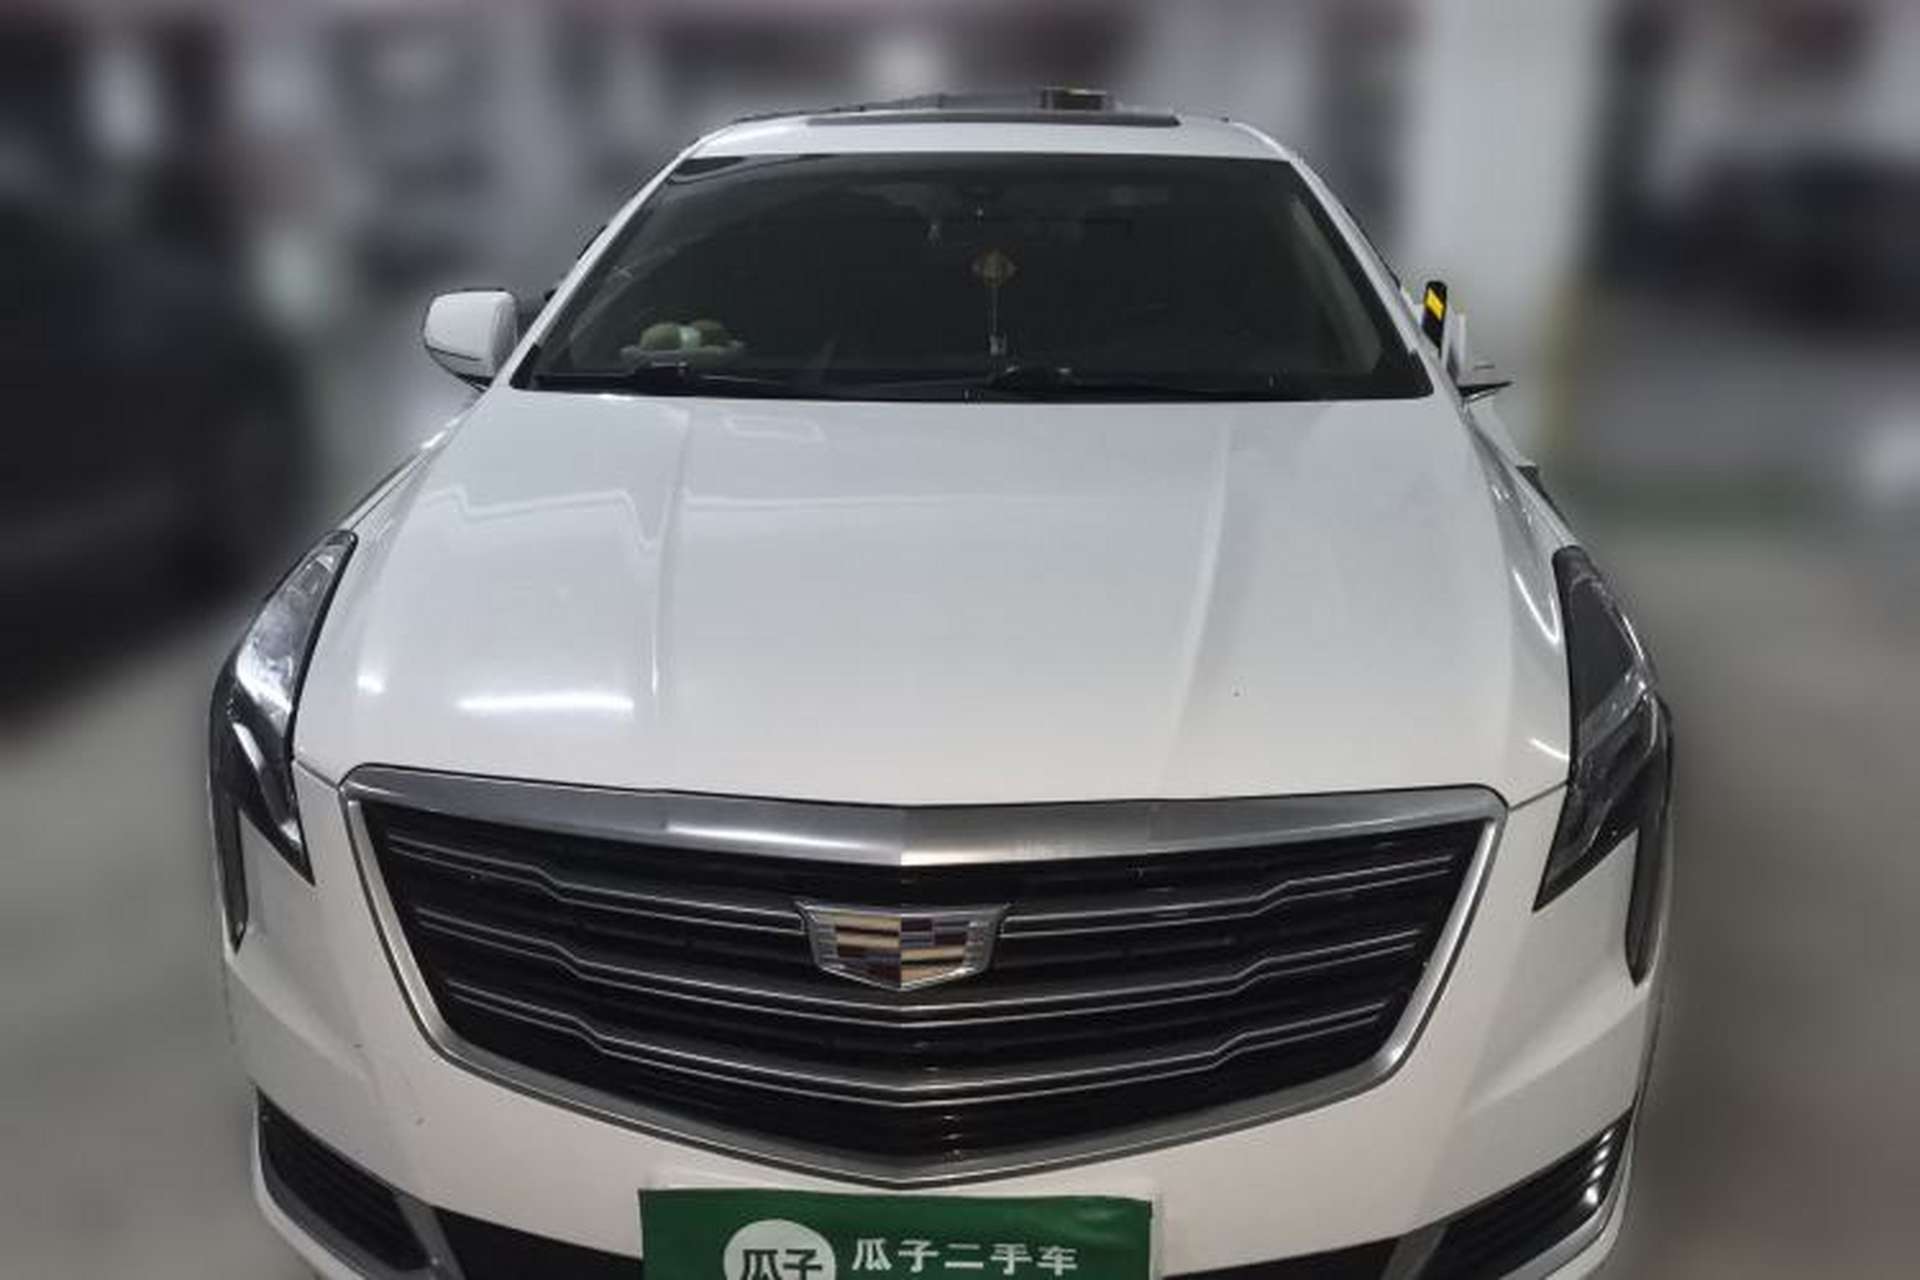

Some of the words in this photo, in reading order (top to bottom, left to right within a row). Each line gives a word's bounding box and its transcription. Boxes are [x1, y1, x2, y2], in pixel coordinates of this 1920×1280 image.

[741, 1248, 822, 1280] 瓜子
[852, 1237, 1078, 1276] 瓜子二手车
